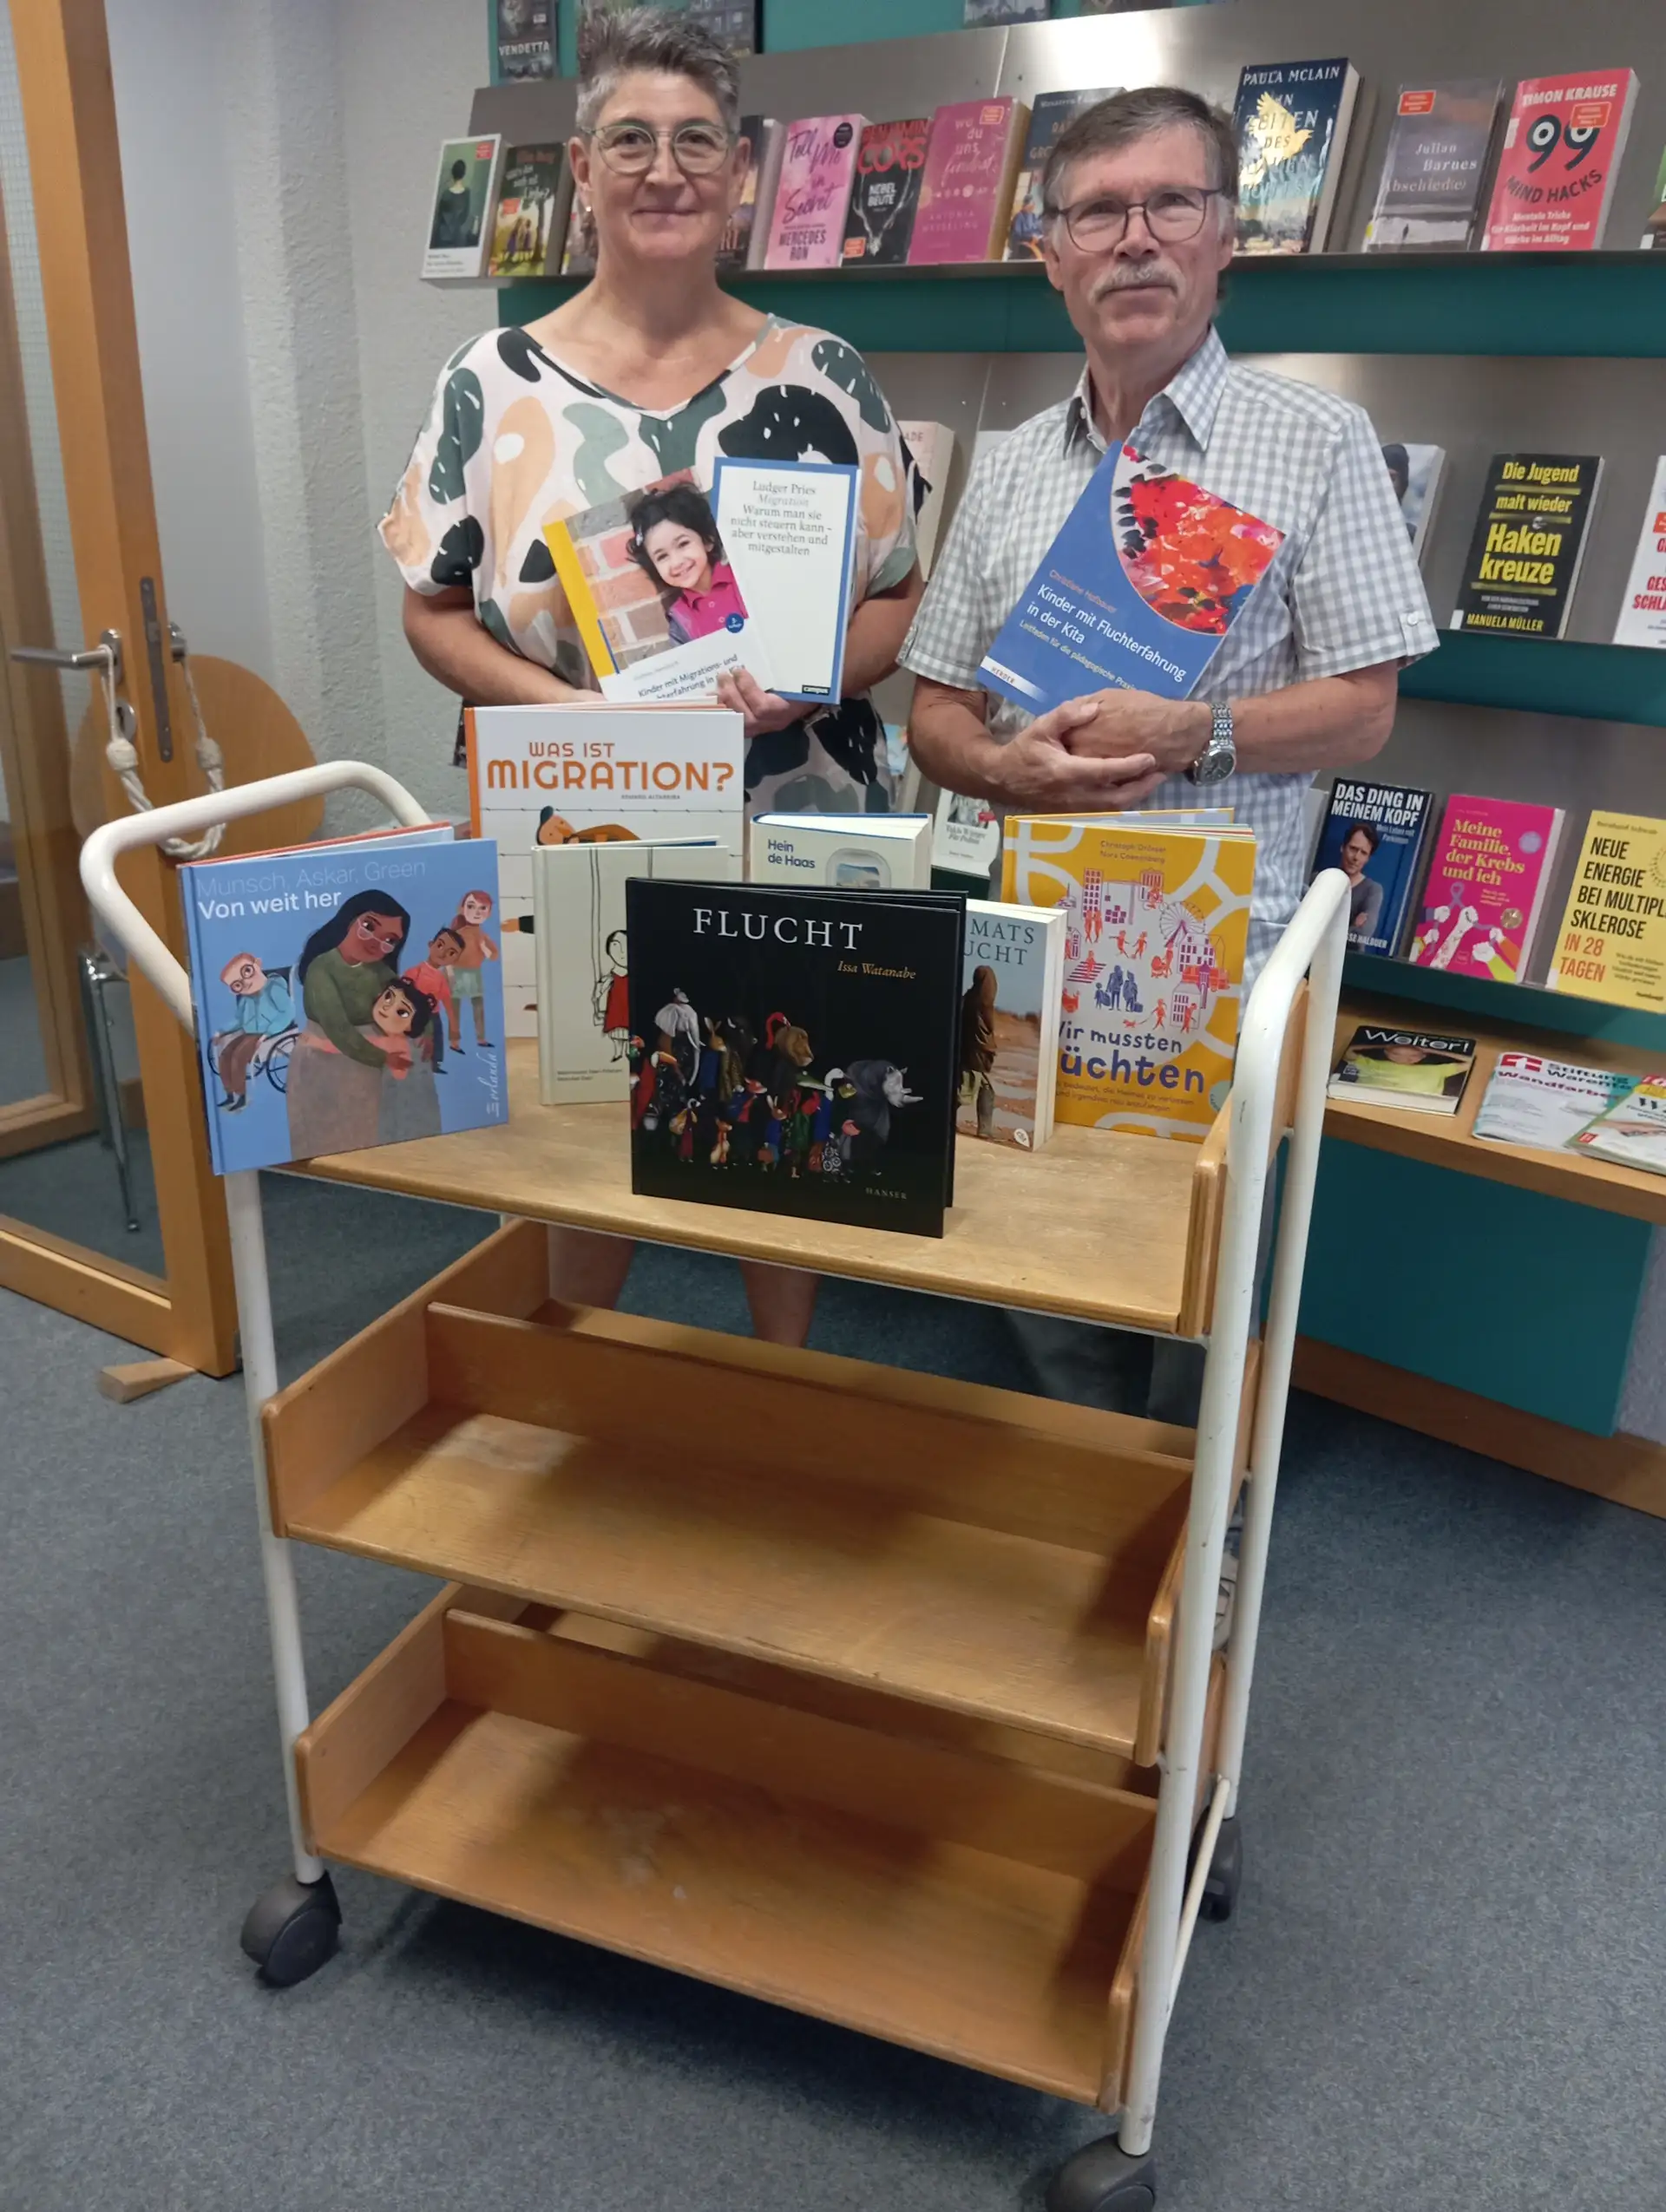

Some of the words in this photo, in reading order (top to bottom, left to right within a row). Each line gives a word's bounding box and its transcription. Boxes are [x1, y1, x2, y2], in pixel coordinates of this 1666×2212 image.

[499, 41, 550, 56] VENDETTA
[1243, 70, 1283, 86] PAULA
[1288, 67, 1341, 82] MCLAIN
[1522, 89, 1564, 107] TIMON
[1565, 84, 1617, 101] KRAUSE
[789, 129, 817, 163] Tell
[1263, 135, 1292, 149] DES
[1415, 142, 1458, 155] Julian
[1525, 115, 1602, 173] 99
[857, 137, 927, 173] CORS
[1423, 160, 1478, 173] Barnes
[869, 183, 896, 196] NEBEL
[1504, 175, 1544, 204] MIND
[1545, 169, 1604, 204] HACKS
[783, 182, 844, 225] Secret
[869, 194, 895, 207] BEUTE
[779, 229, 827, 246] MERCEDES
[790, 247, 810, 260] RON
[1502, 461, 1525, 480] Die
[1526, 463, 1580, 486] Jugend
[752, 481, 788, 494] Ludger
[790, 483, 817, 495] Pries
[743, 504, 781, 517] Warum
[783, 509, 805, 520] man
[808, 510, 823, 520] sie
[758, 494, 810, 507] Migration
[1496, 494, 1525, 510] malt
[1527, 494, 1572, 513] wieder
[731, 517, 757, 527] nicht
[759, 520, 797, 531] steuern
[799, 521, 824, 533] kann
[731, 527, 754, 539] aber
[757, 532, 806, 544] verstehen
[808, 534, 829, 546] und
[748, 542, 810, 557] mitgestalten
[1486, 523, 1562, 556] Haken
[1479, 553, 1554, 585] kreuze
[1026, 600, 1040, 618] in
[1040, 607, 1062, 629] der
[1061, 622, 1086, 645] Kita
[1037, 583, 1077, 614] Kinder
[1076, 610, 1098, 628] mit
[1096, 618, 1187, 684] Fluchterfahrung
[1466, 613, 1508, 629] MANUELA
[1508, 615, 1545, 633] MÜLLER
[1020, 619, 1050, 643] Leitfaden
[1049, 637, 1061, 649] für
[1059, 645, 1072, 656] die
[1070, 651, 1116, 682] pädagogische
[638, 684, 665, 697] Kinder
[664, 678, 679, 689] mit
[679, 662, 723, 682] Migrations-
[723, 653, 738, 666] und
[706, 675, 715, 684] in
[529, 742, 575, 758] WAS
[583, 742, 615, 758] IST
[487, 759, 734, 792] MIGRATION?
[1335, 784, 1366, 804] DAS
[1367, 788, 1404, 811] DING
[1406, 793, 1424, 811] IN
[1331, 800, 1383, 822] MEINEM
[1384, 807, 1420, 828] KOPF
[1453, 818, 1503, 839] Meine
[768, 839, 794, 853] Hein
[1449, 833, 1512, 857] Familie,
[1591, 836, 1630, 860] NEUE
[767, 852, 783, 864] de
[784, 854, 816, 869] Haas
[1446, 848, 1473, 865] der
[1475, 853, 1525, 874] Krebs
[196, 870, 291, 898] Munsch,
[296, 867, 358, 889] Askar,
[364, 861, 425, 881] Green
[1442, 866, 1474, 880] und
[1476, 868, 1502, 886] ich
[1584, 861, 1646, 888] ENERGIE
[199, 900, 245, 919] Von
[251, 893, 300, 914] weit
[305, 890, 342, 908] her
[1577, 885, 1603, 906] BEI
[693, 907, 863, 951] FLUCHT
[970, 918, 1036, 945] MATS
[1571, 909, 1647, 939] SKLEROSE
[963, 939, 1028, 965] UCHT
[1564, 933, 1581, 952] IN
[1584, 937, 1604, 957] 28
[837, 959, 858, 973] Issa
[861, 962, 916, 980] Watanabe
[1559, 957, 1606, 983] TAGEN
[1091, 1030, 1182, 1053] mussten
[1365, 1030, 1469, 1053] Weiter!
[1060, 1045, 1204, 1094] üchten
[1547, 1070, 1634, 1090] Warente
[1548, 1063, 1630, 1084] Stiftung
[866, 1188, 908, 1200] HANSER
